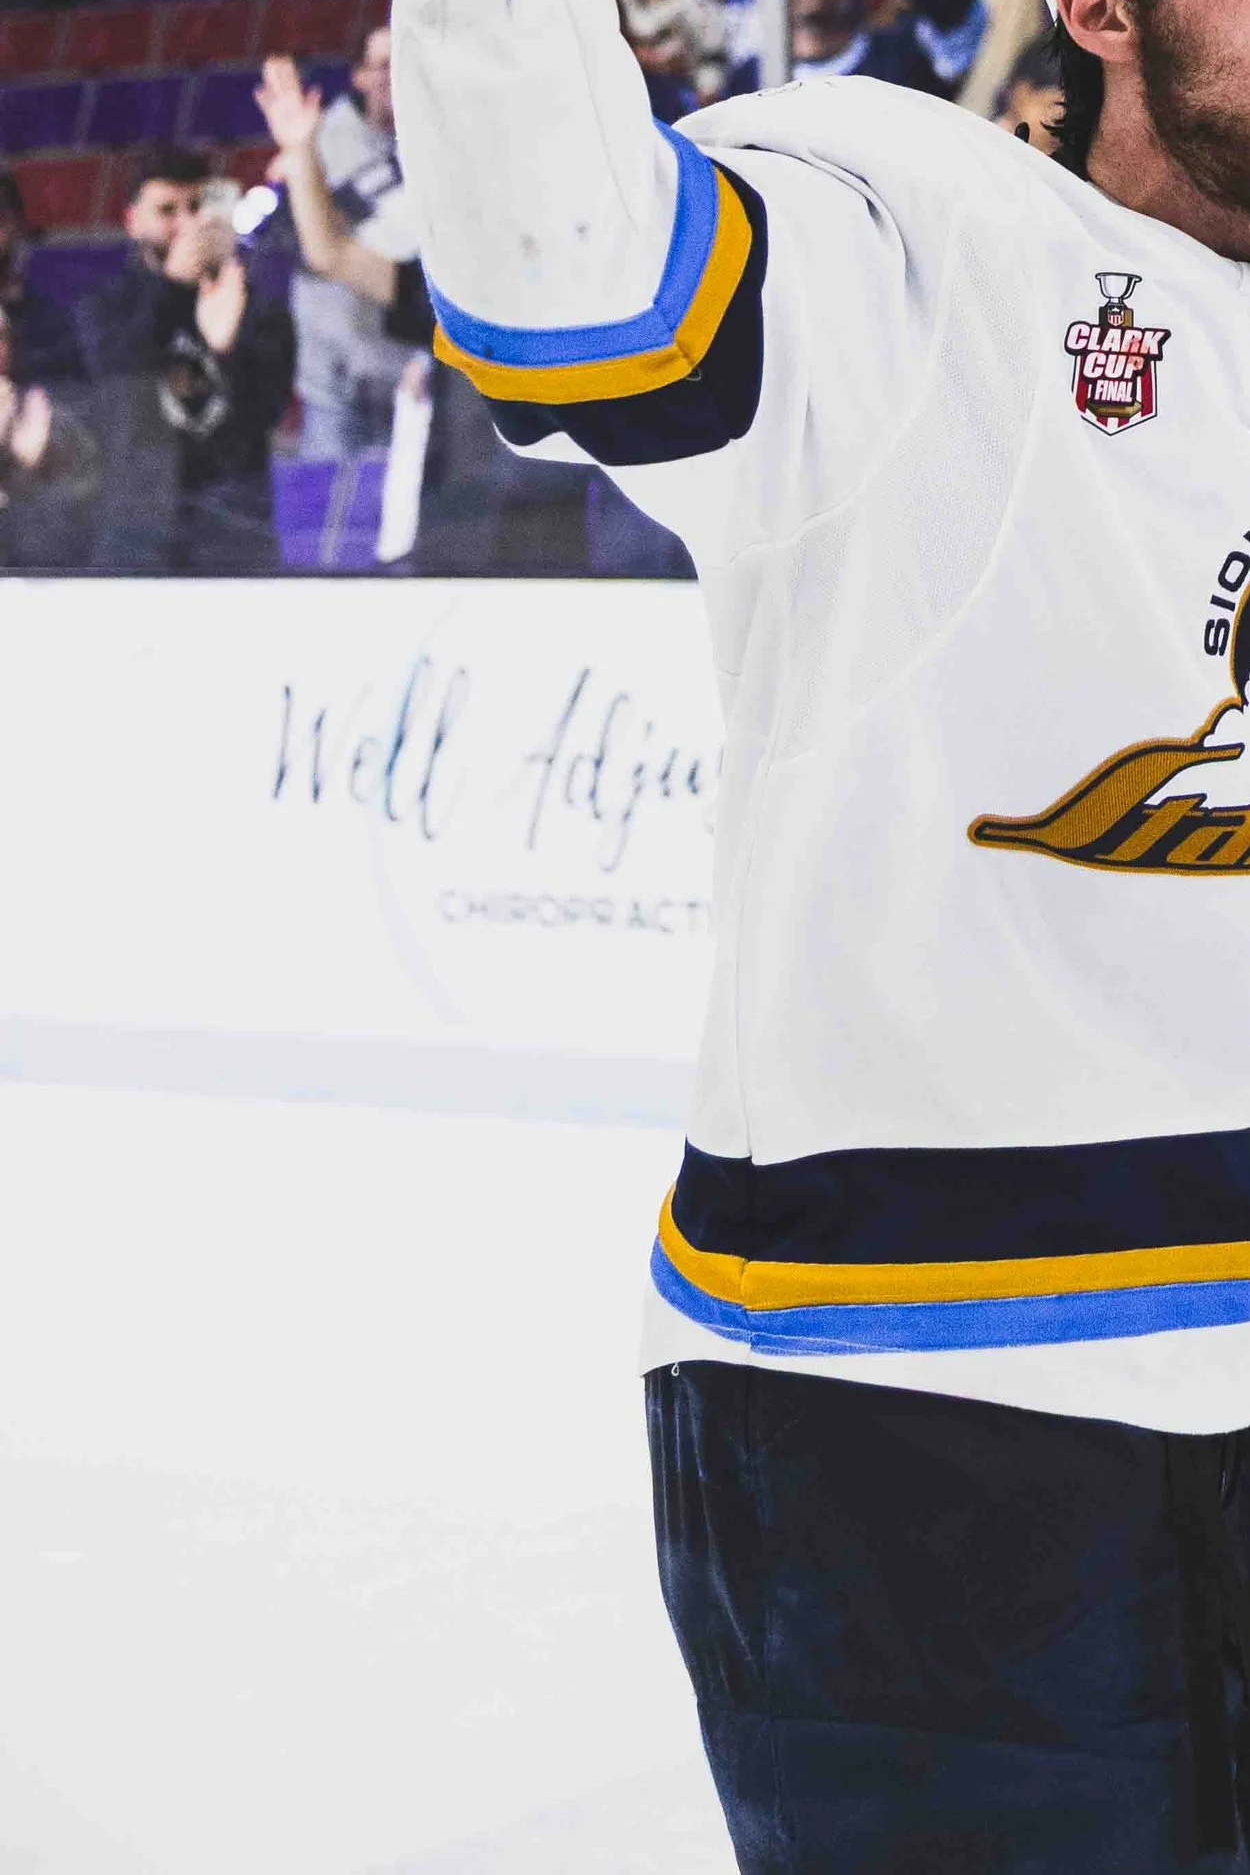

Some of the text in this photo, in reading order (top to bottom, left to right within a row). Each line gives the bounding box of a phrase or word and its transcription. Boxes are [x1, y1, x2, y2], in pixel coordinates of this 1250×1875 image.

[1066, 322, 1166, 356] CLARK
[1082, 351, 1145, 379] CUP
[1094, 379, 1134, 404] FINAL
[271, 654, 708, 873] Well Adju
[436, 888, 712, 934] CHIROPRACT
